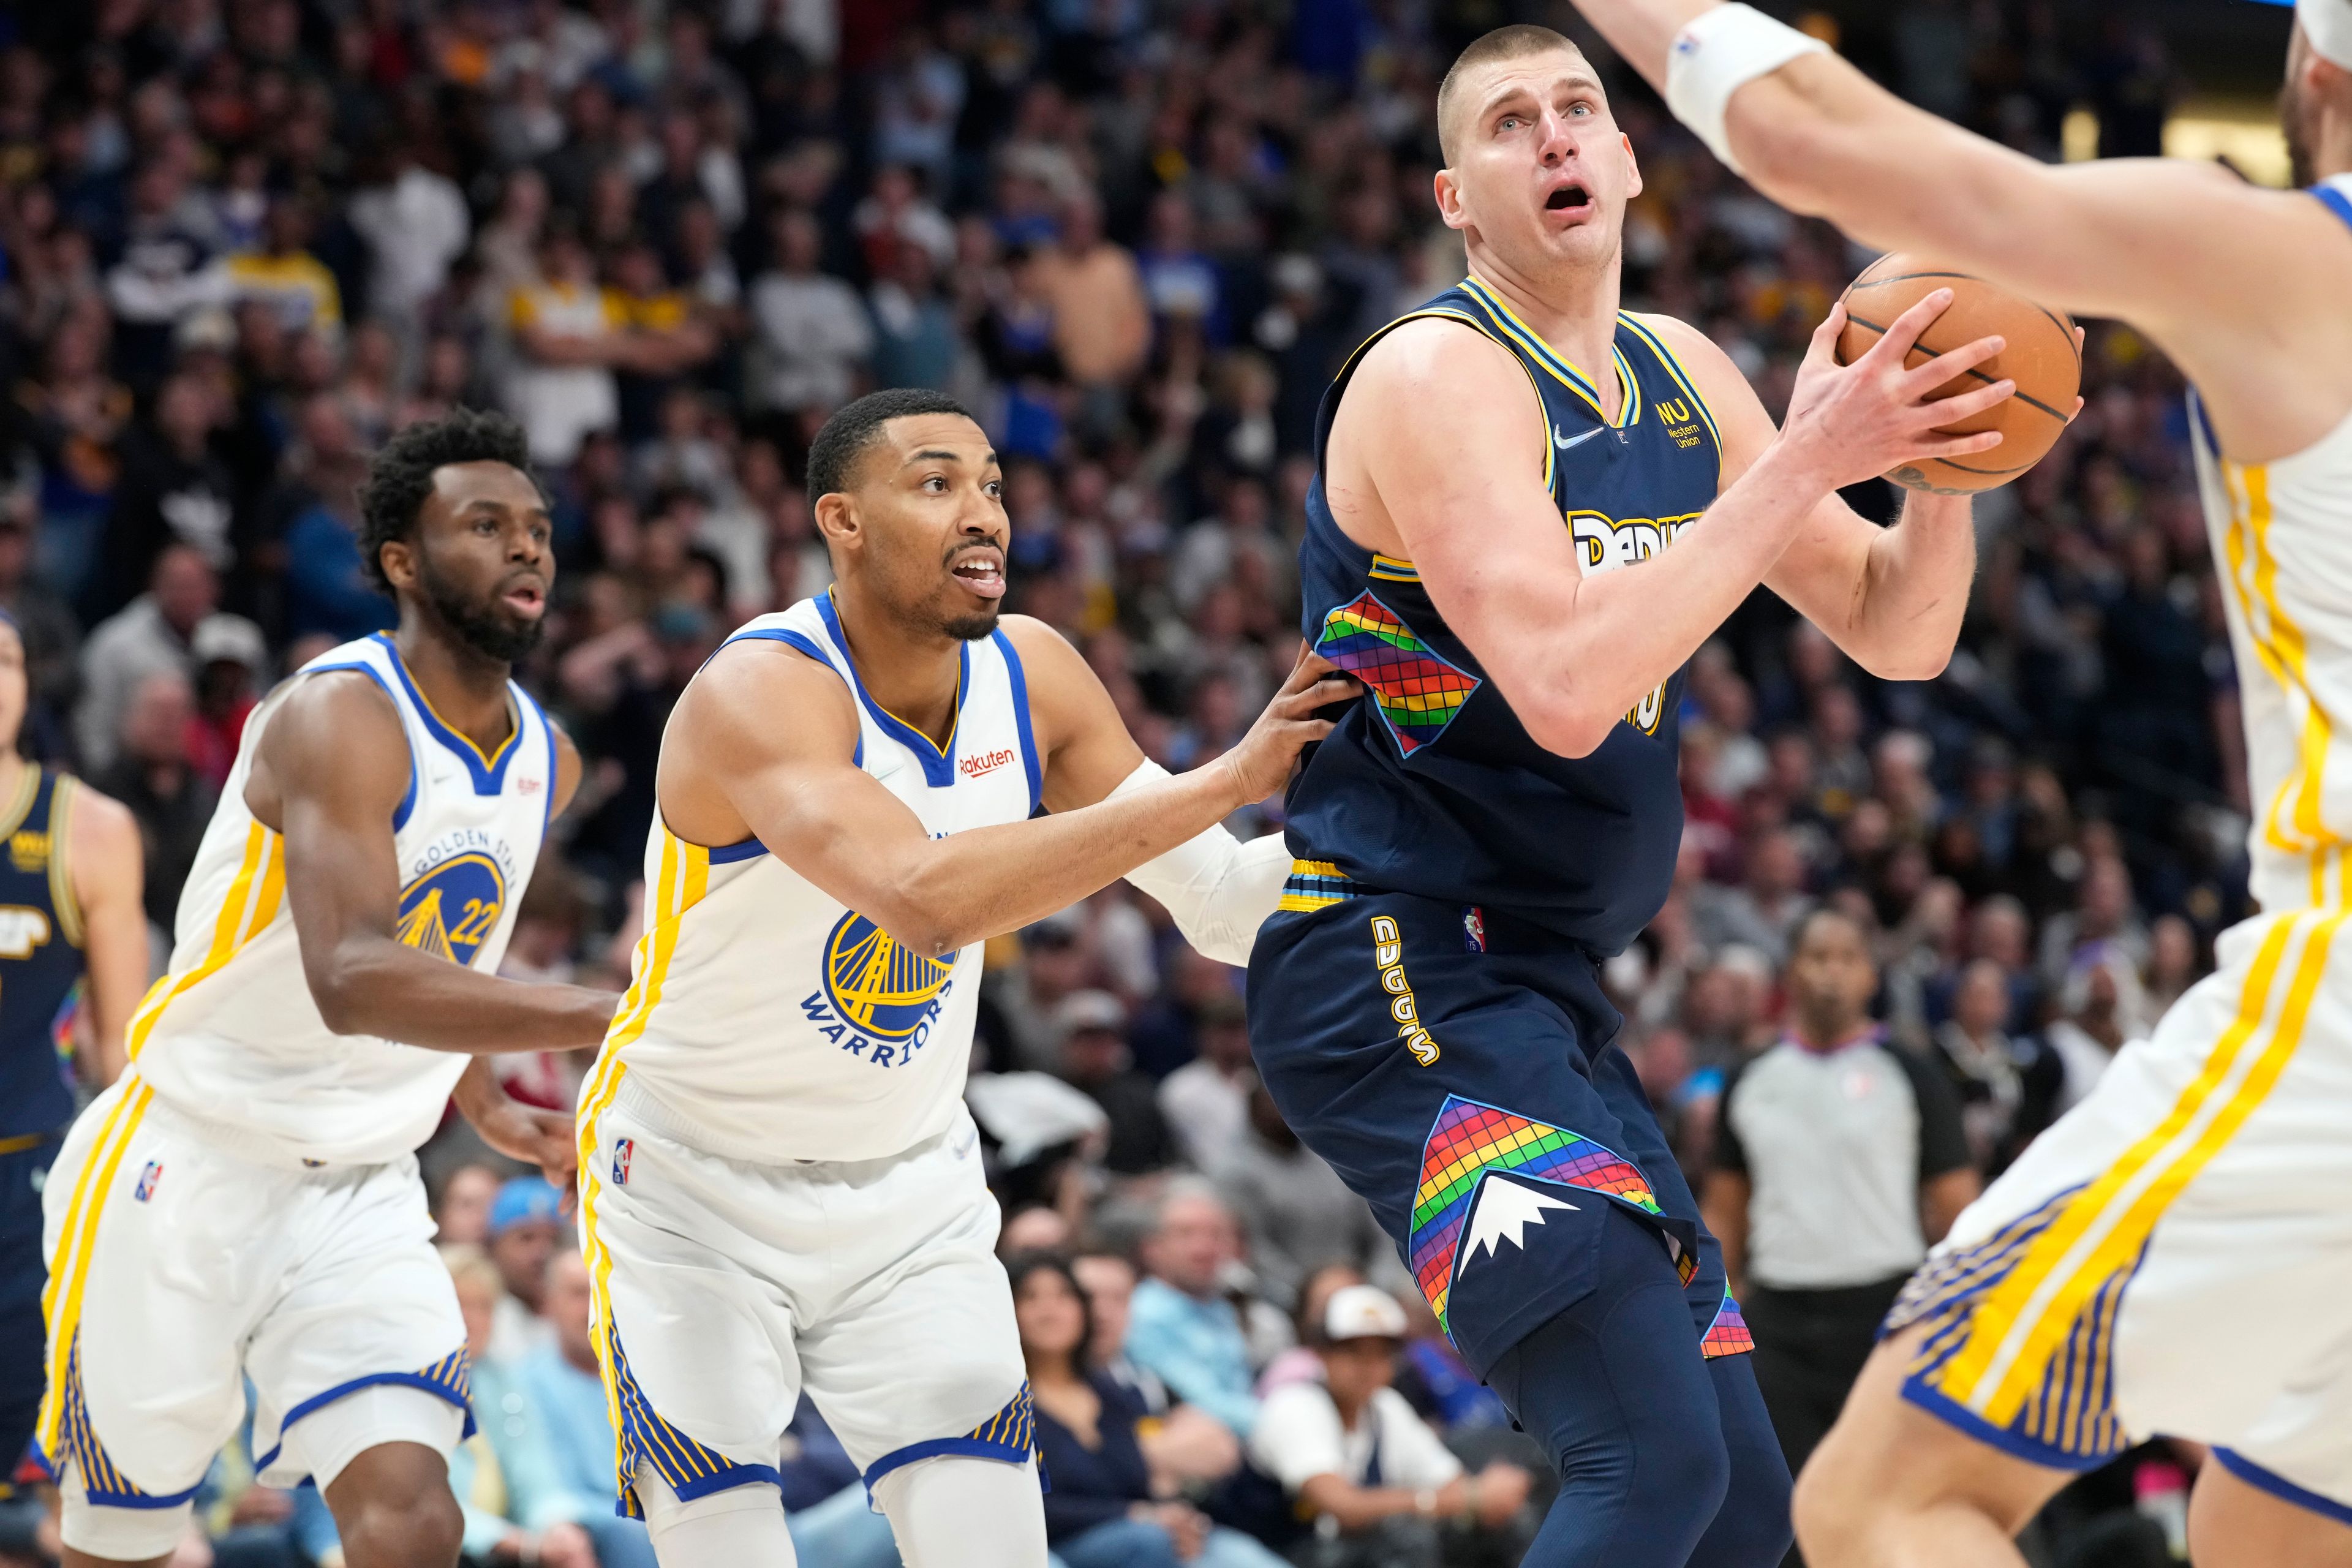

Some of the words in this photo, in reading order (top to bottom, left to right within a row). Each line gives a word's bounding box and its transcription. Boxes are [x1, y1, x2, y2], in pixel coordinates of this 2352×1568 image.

[1667, 424, 1700, 439] Western
[1675, 436, 1701, 448] Union
[960, 749, 1015, 776] Rakuten
[415, 828, 490, 876] GOLDEN
[449, 897, 499, 944] 22
[1468, 940, 1476, 951] 75
[800, 979, 953, 1068] WARRIORS
